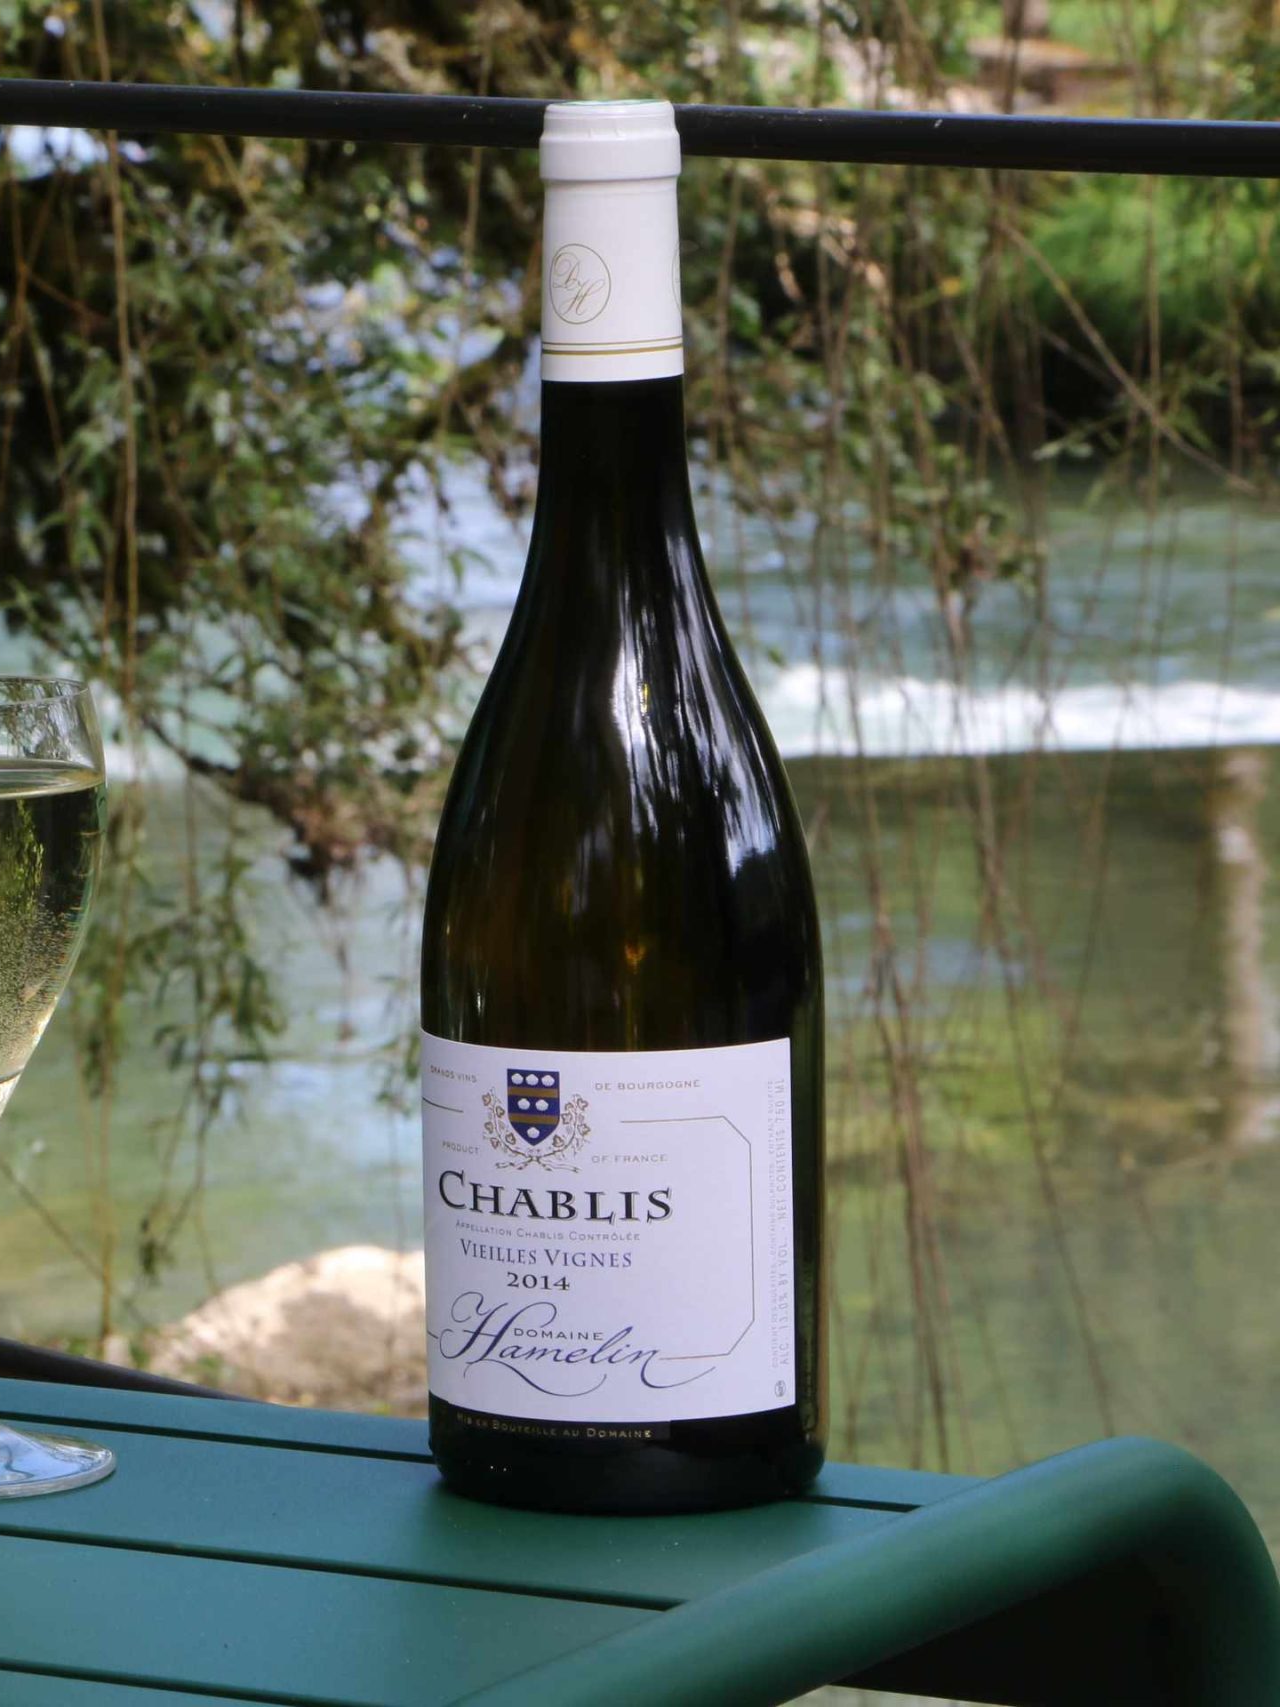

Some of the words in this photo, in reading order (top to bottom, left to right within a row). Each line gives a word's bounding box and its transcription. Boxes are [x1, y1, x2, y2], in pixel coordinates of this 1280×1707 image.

[457, 1072, 478, 1083] VINS
[594, 1083, 612, 1091] DE
[617, 1079, 701, 1091] BOURGOGNE
[442, 1141, 480, 1155] PRODUCT
[591, 1155, 610, 1163] OF
[614, 1153, 669, 1163] FRANCE
[438, 1169, 674, 1225] CHABLIS
[506, 1271, 571, 1291] 2014
[513, 1327, 605, 1341] DOMAINE
[439, 1291, 717, 1397] Hamelin
